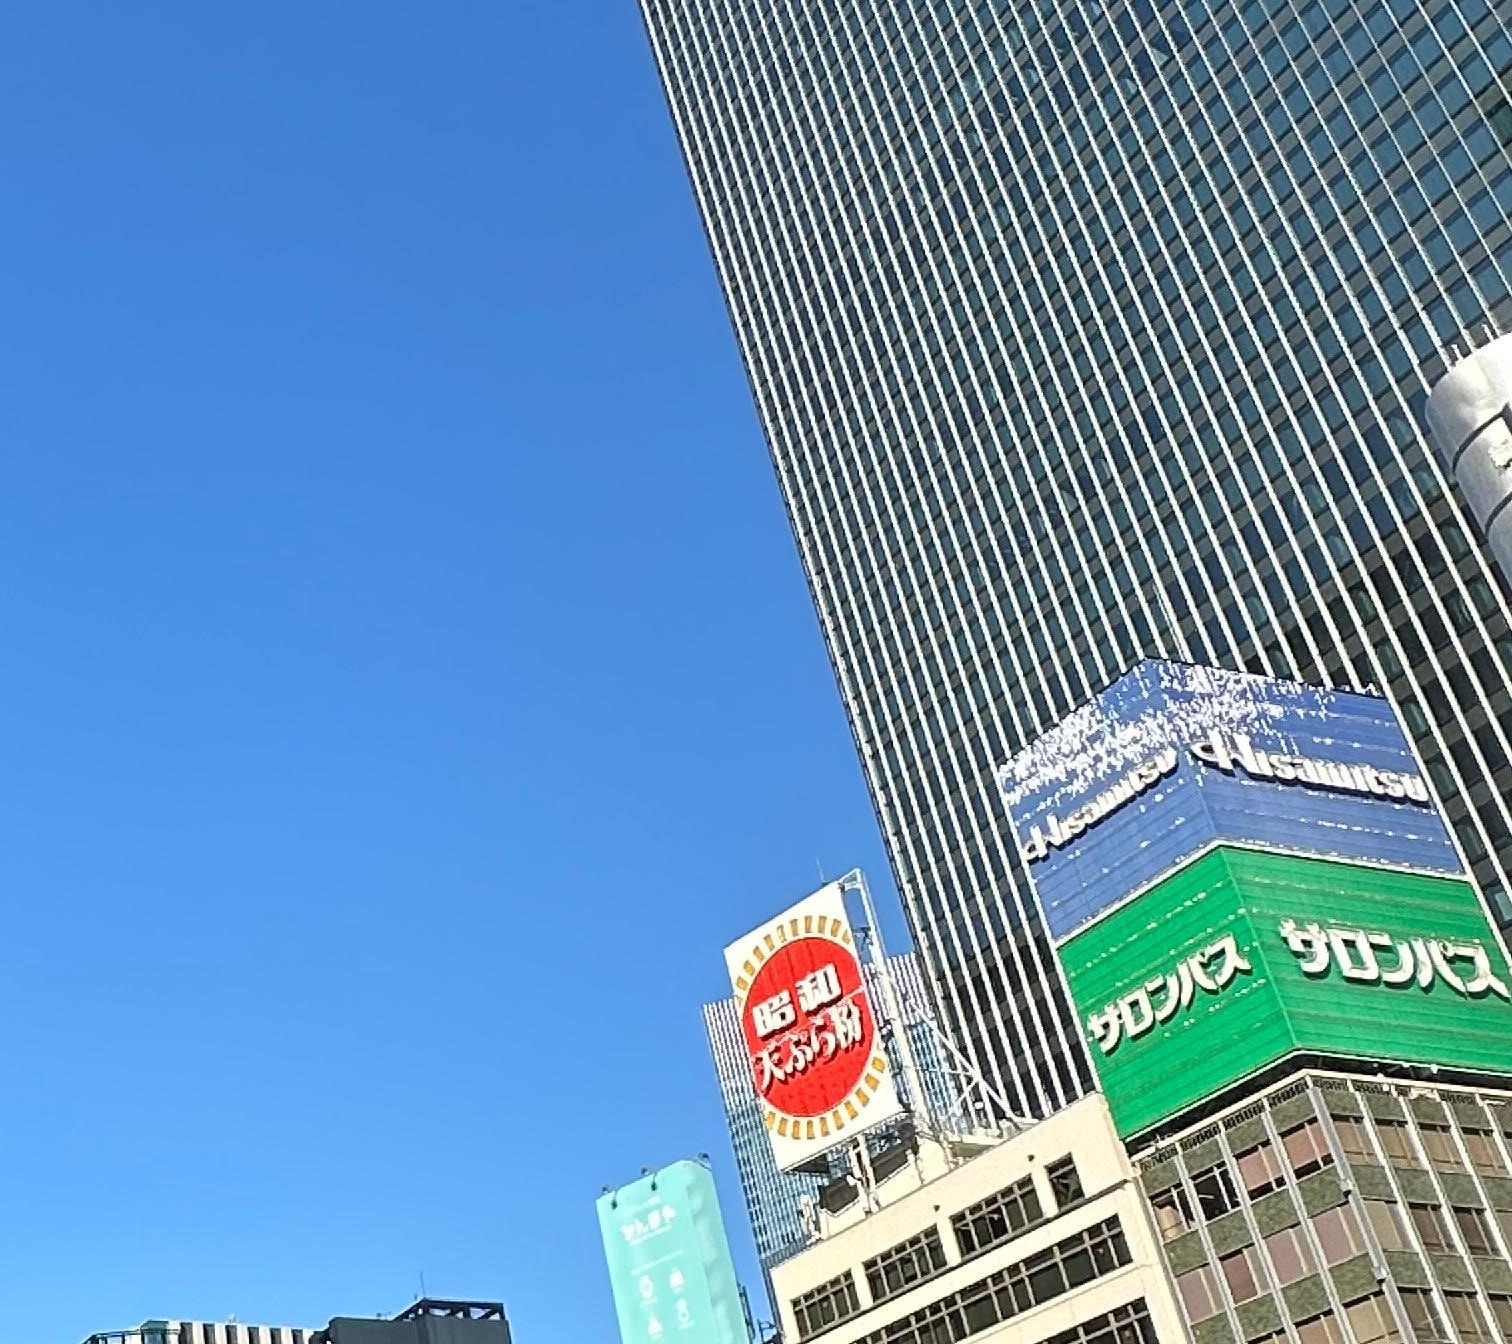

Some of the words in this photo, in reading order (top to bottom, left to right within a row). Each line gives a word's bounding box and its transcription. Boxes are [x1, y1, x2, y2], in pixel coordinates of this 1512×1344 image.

[1189, 729, 1431, 803] Hisamitsu
[752, 963, 842, 1039] 昭和
[1088, 933, 1252, 1054] サロンパス
[1280, 918, 1512, 1002] サロンパス
[753, 998, 863, 1092] 天ぷら粉
